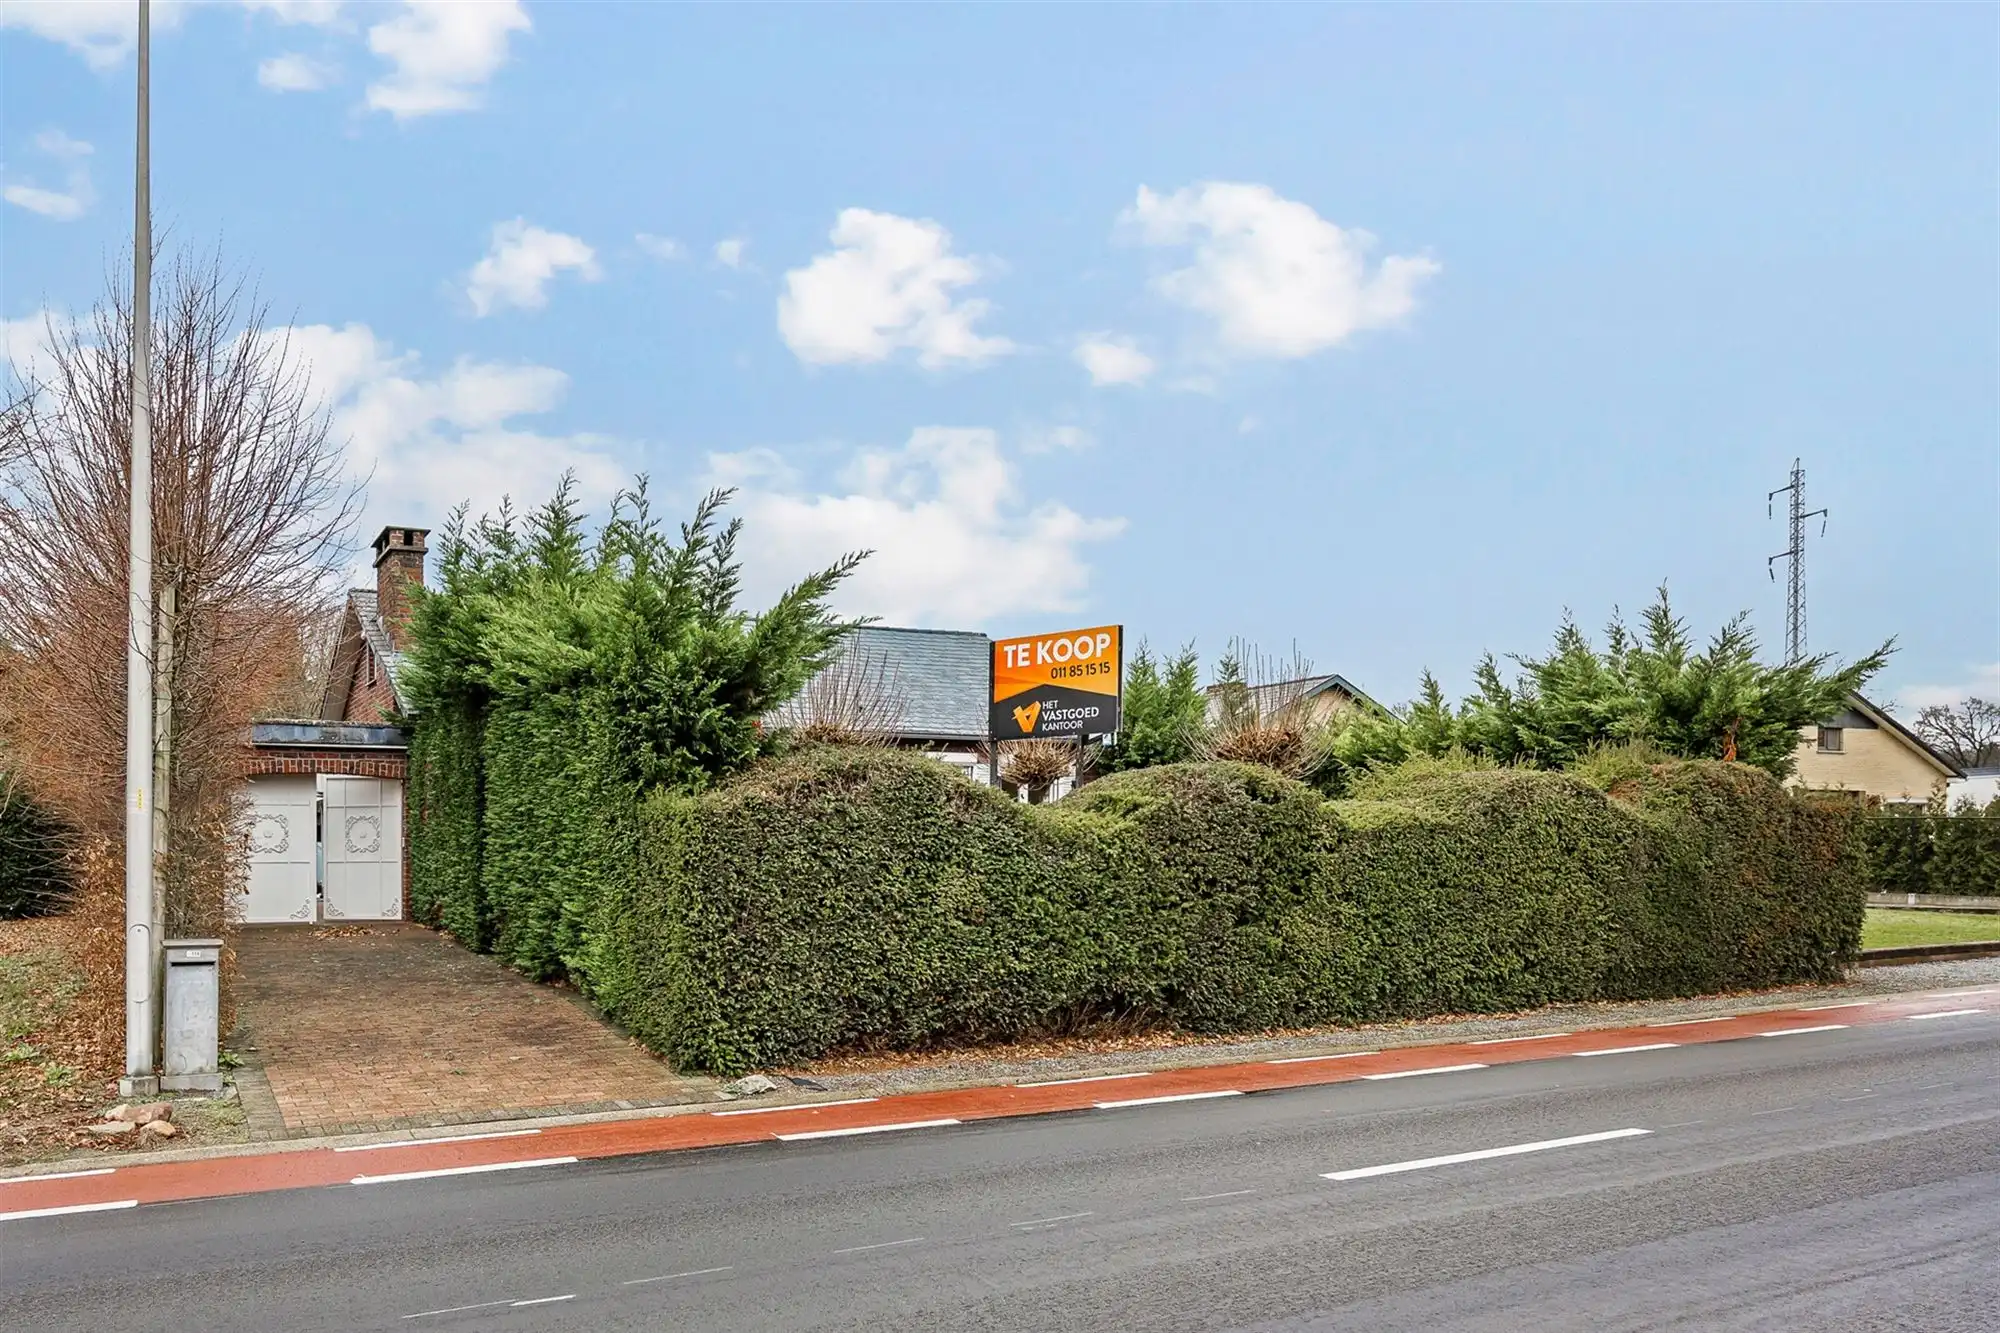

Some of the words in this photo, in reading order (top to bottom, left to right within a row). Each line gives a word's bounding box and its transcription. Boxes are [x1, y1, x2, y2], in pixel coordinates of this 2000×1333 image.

[1003, 644, 1030, 668] TE
[1037, 633, 1111, 665] KOOP
[1051, 667, 1066, 679] 011
[1070, 664, 1083, 677] 85
[1086, 663, 1097, 675] 15
[1099, 661, 1110, 673] 15
[1042, 700, 1058, 709] HET
[1042, 706, 1099, 721] VASTGOED
[1041, 720, 1083, 731] KANTOOR
